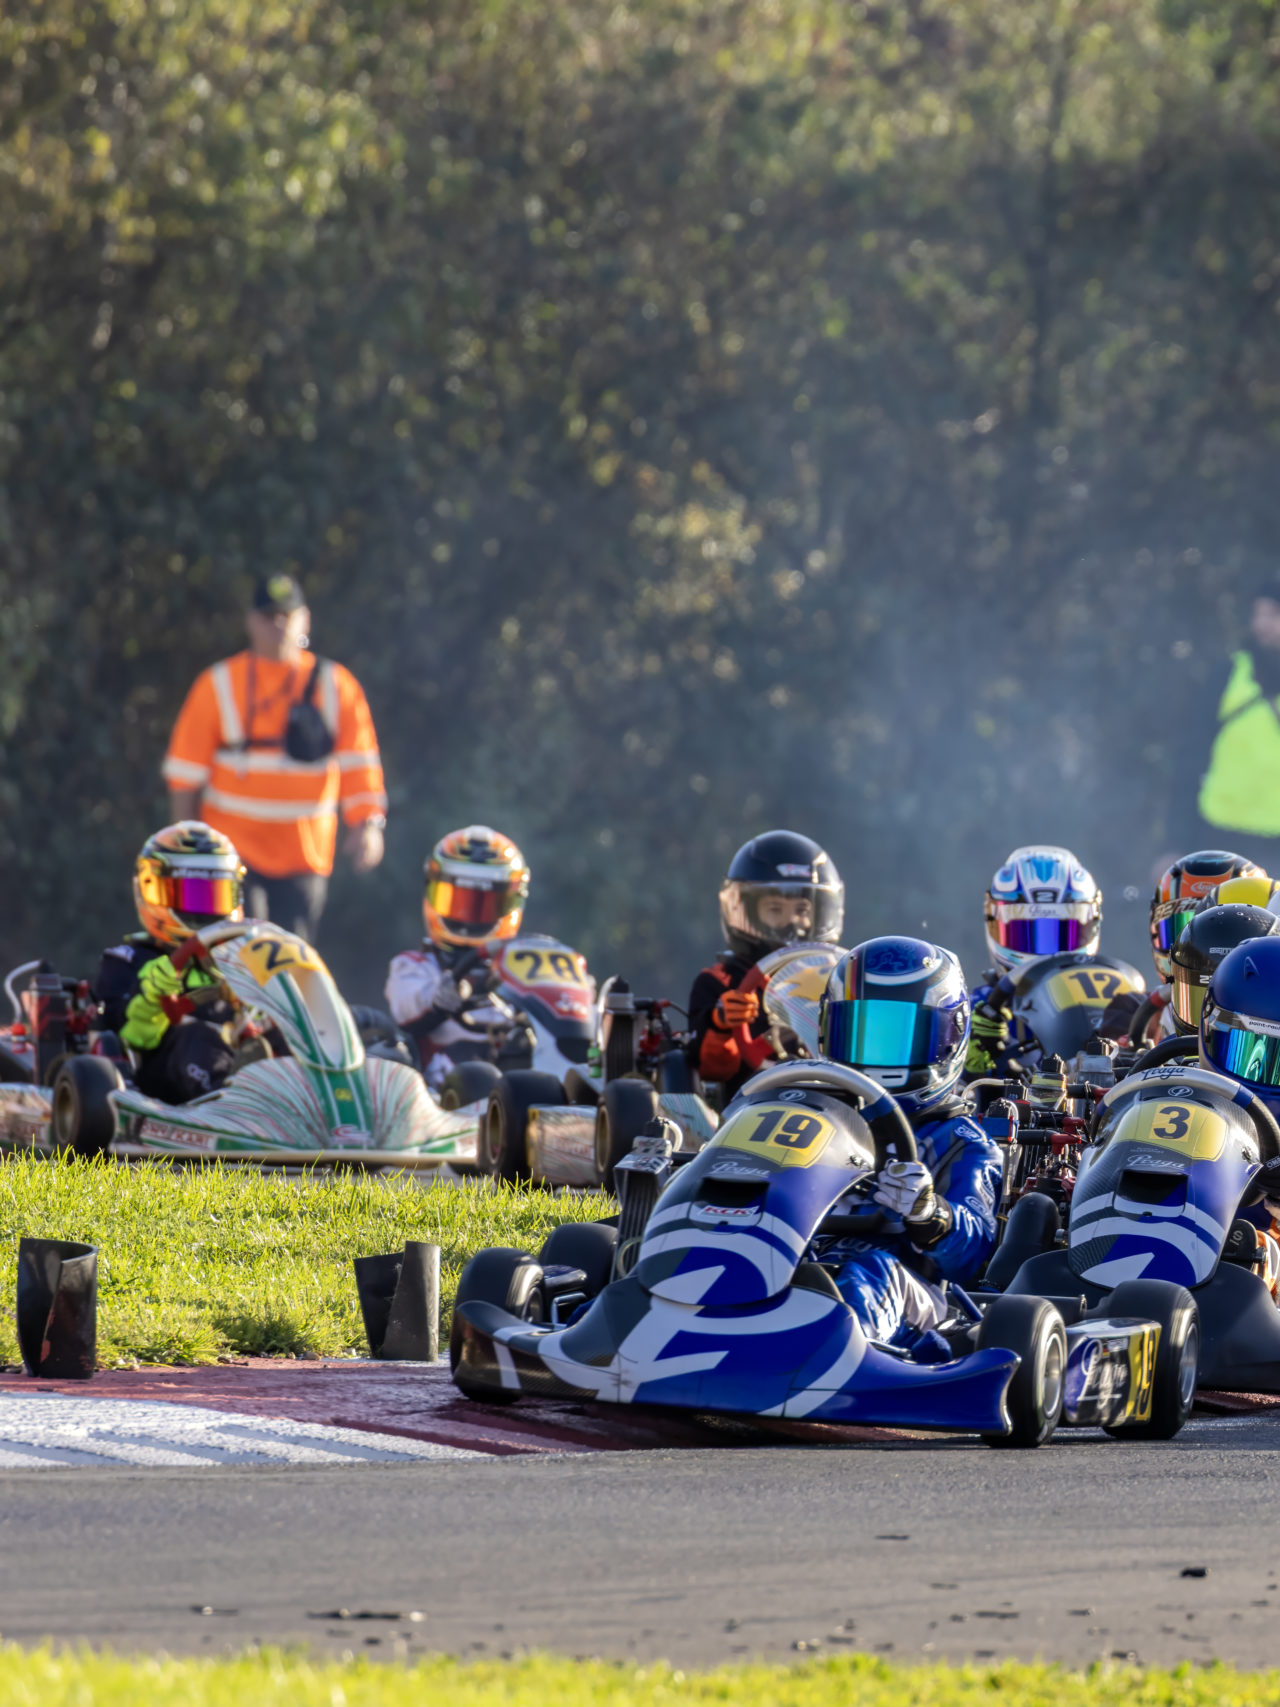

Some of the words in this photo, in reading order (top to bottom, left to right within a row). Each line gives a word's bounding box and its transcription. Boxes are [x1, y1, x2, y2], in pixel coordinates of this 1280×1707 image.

[1068, 972, 1123, 999] 12
[749, 1110, 823, 1149] 19
[1153, 1105, 1191, 1140] 3
